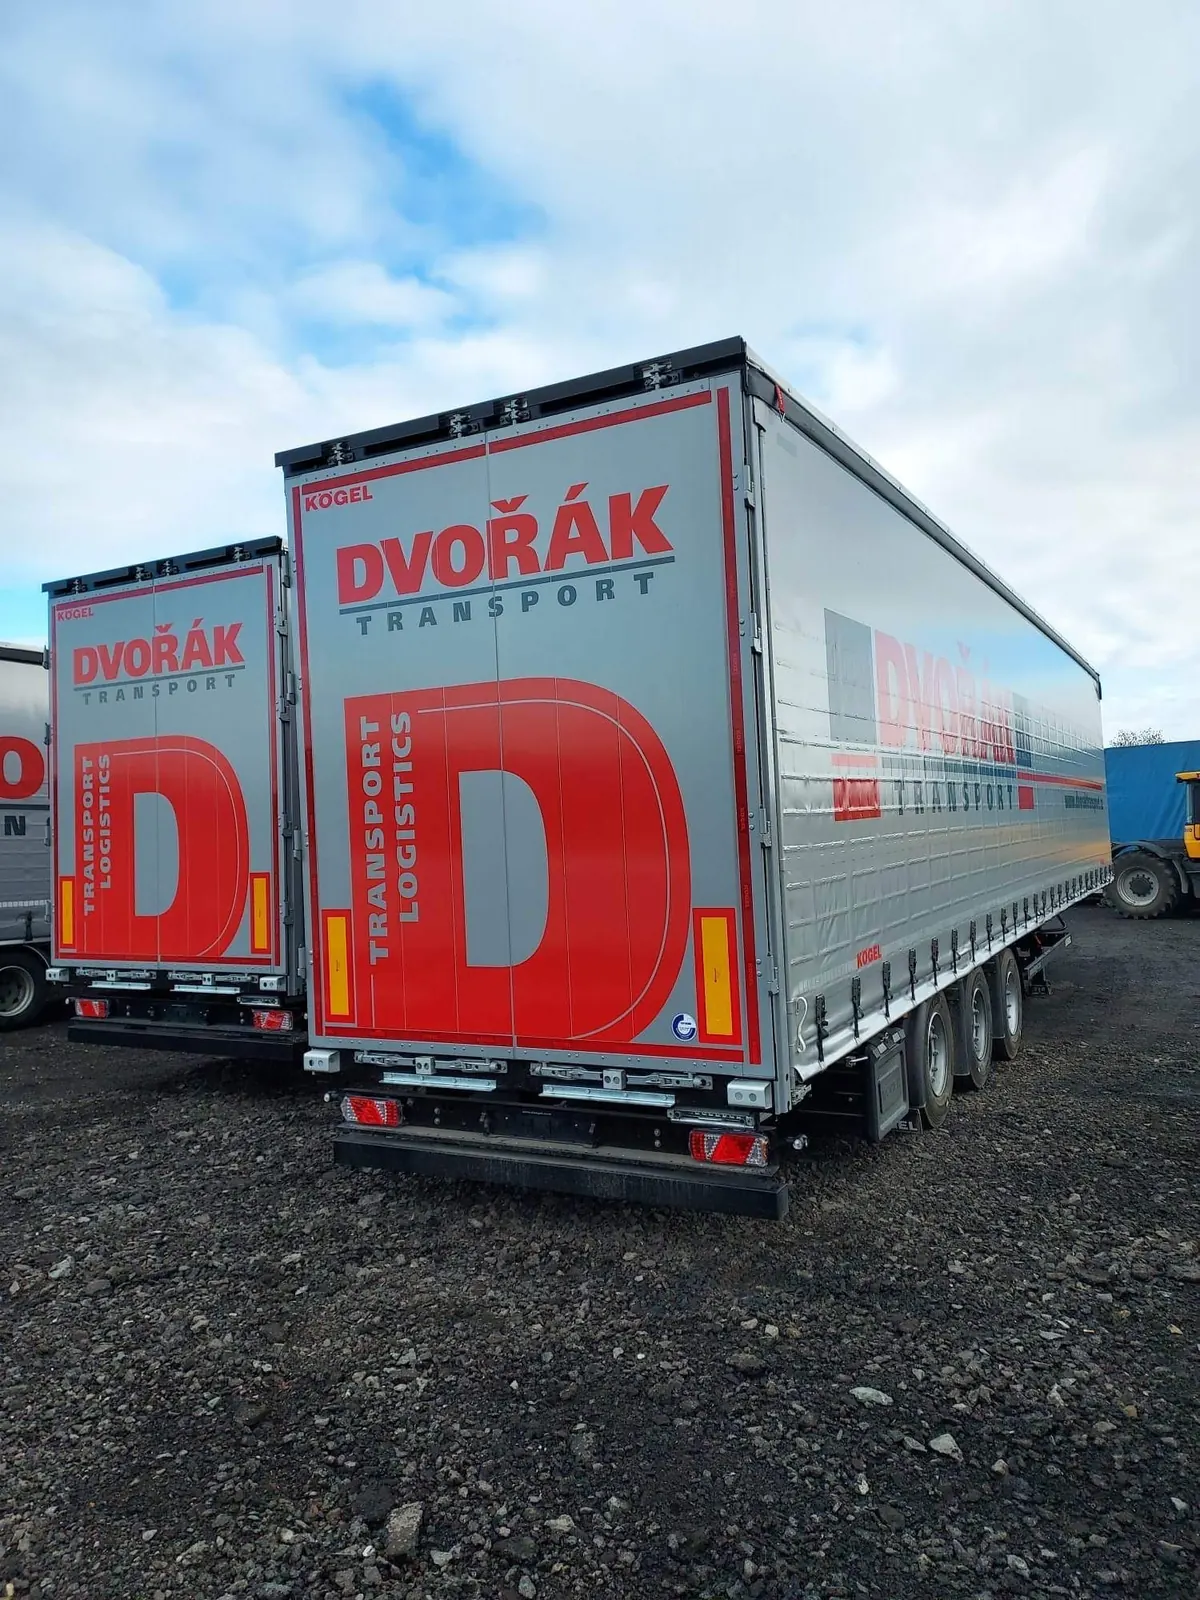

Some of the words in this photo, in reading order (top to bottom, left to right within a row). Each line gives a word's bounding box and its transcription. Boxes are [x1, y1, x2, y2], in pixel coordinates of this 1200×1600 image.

[336, 482, 674, 606] DVOŘÁK
[356, 572, 655, 635] TRANSPORT
[72, 618, 246, 683] DVOŘÁK
[82, 674, 236, 706] TRANSPORT
[82, 756, 95, 916] TRANSPORT
[98, 753, 111, 889] LOGISTICS
[359, 715, 390, 965] TRANSPORT
[391, 710, 420, 923] LOGISTICS
[894, 778, 1014, 816] TRANSPORT
